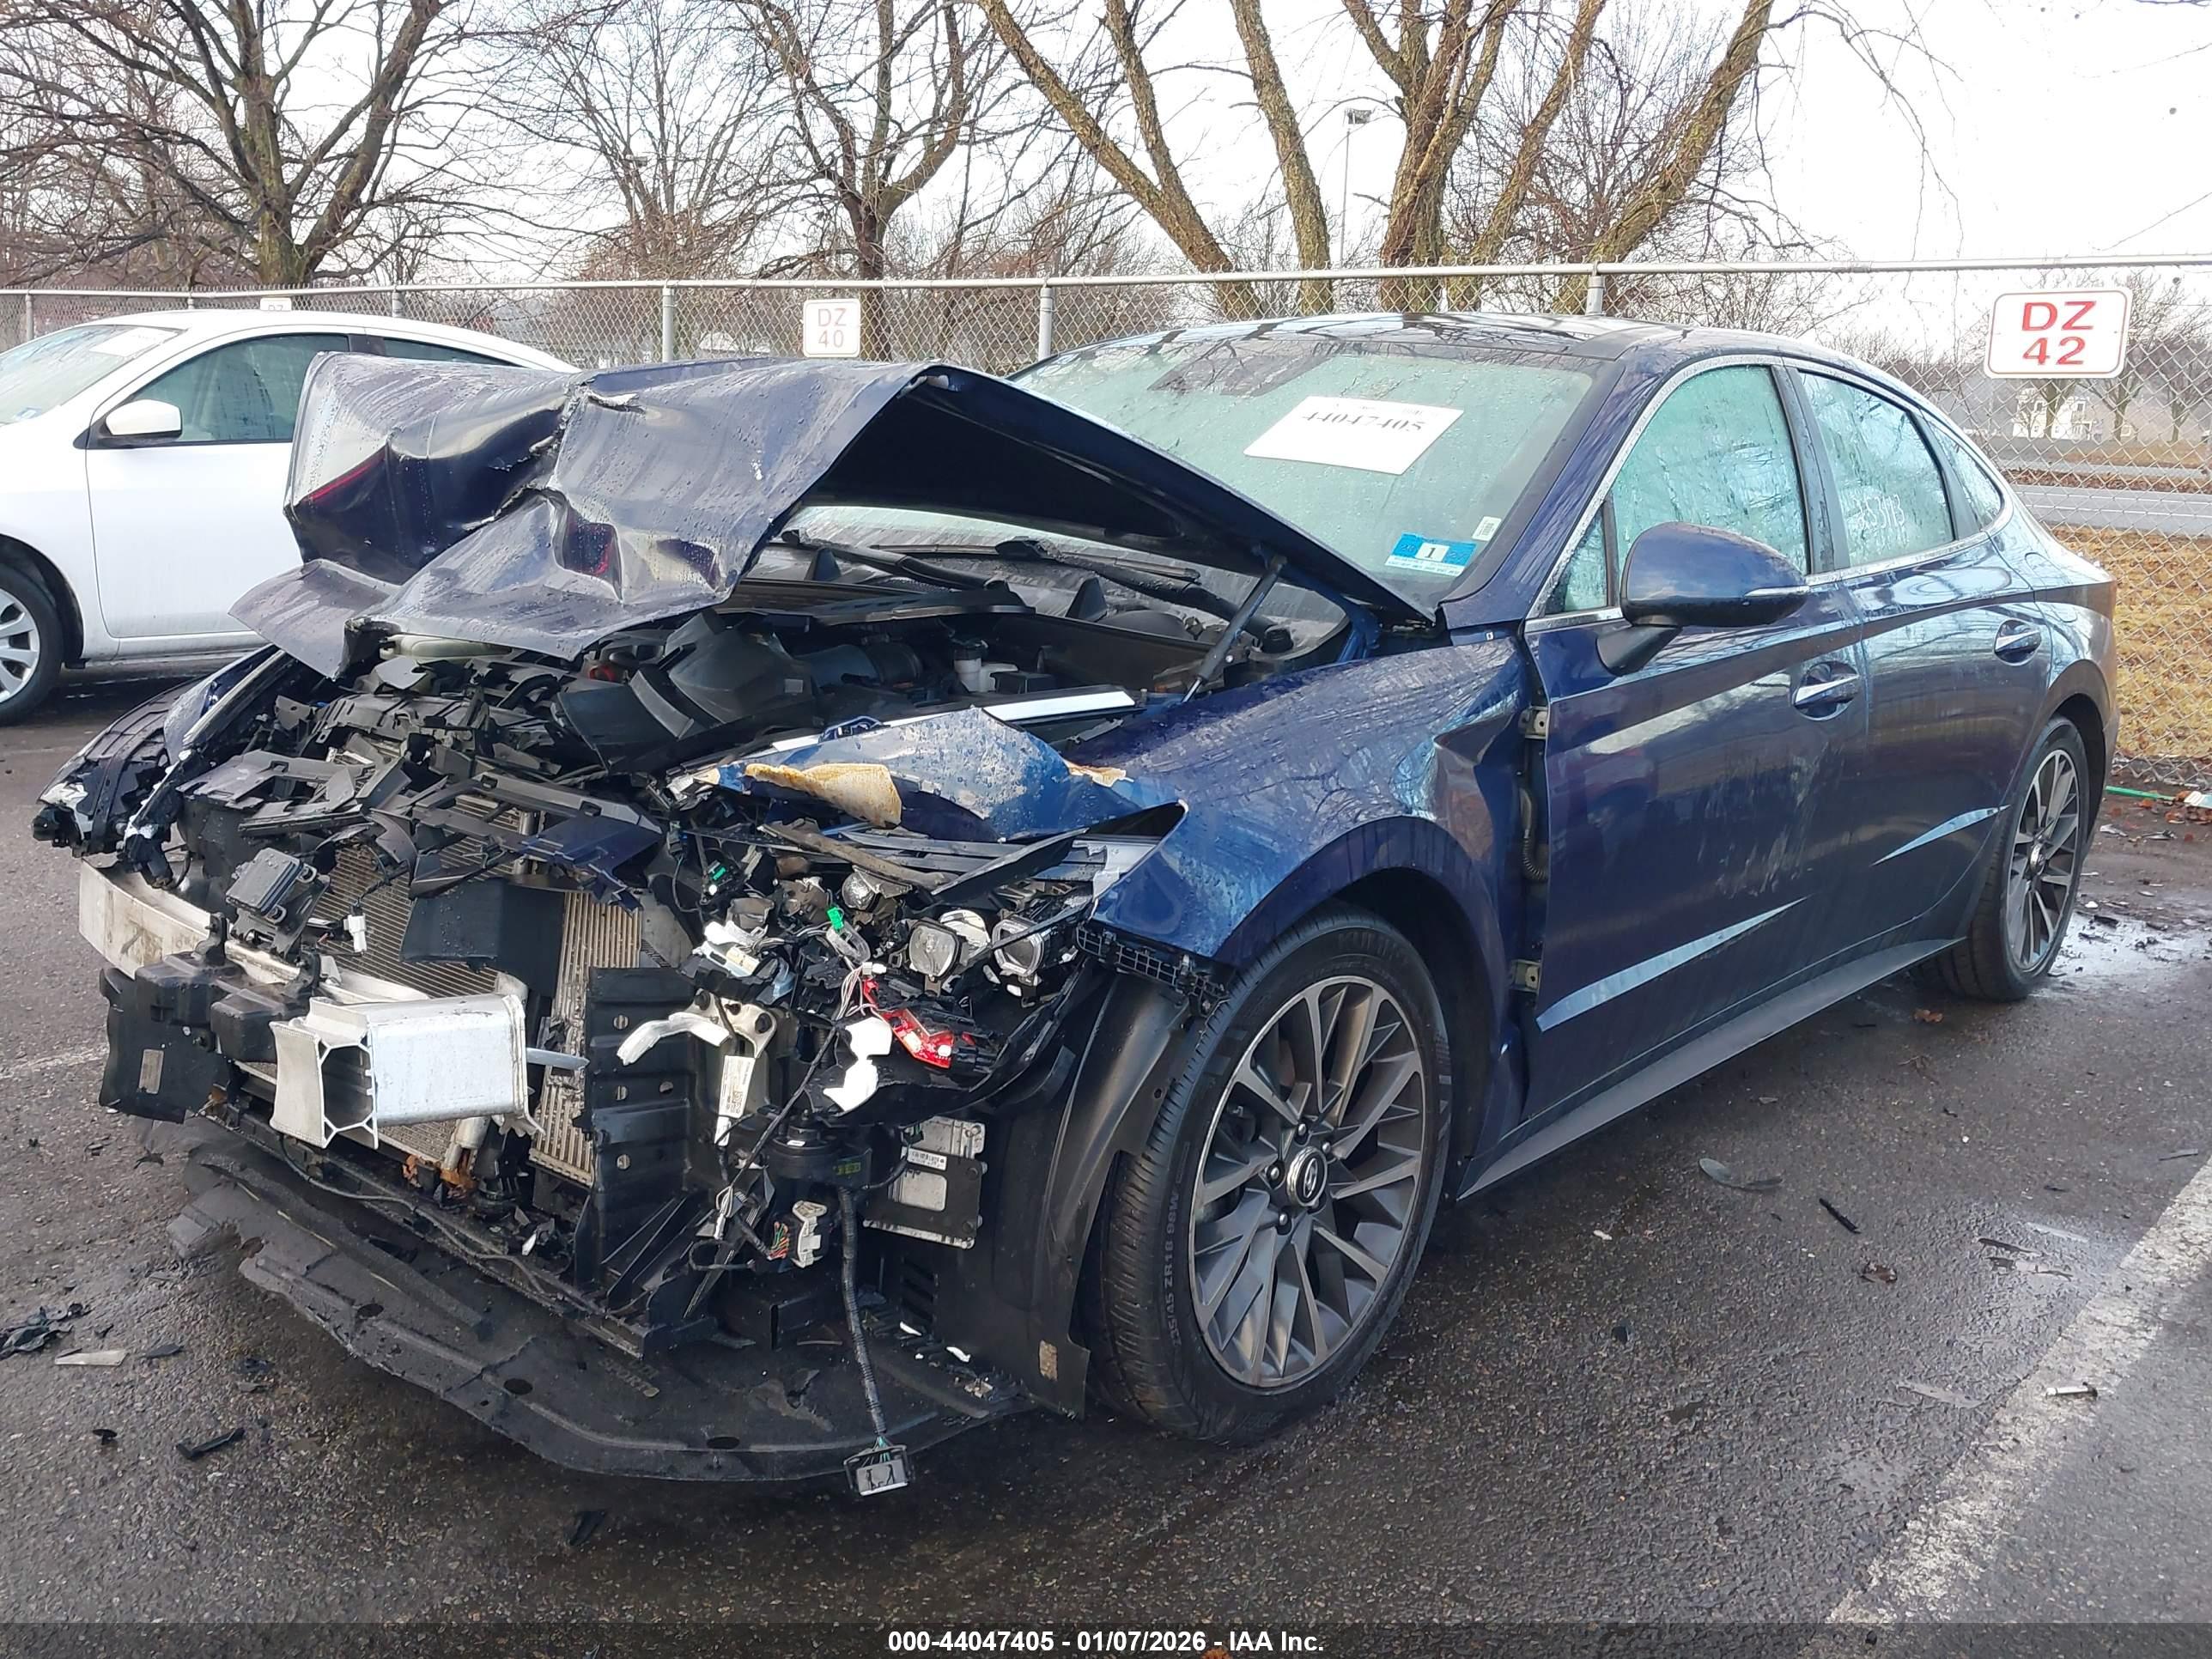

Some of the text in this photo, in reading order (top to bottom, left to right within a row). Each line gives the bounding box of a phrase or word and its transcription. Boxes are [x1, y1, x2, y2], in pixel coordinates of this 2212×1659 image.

[817, 307, 847, 326] DZ
[2021, 301, 2097, 331] DZ
[817, 329, 844, 348] 40
[2021, 336, 2087, 365] 42
[1424, 547, 1437, 559] 1
